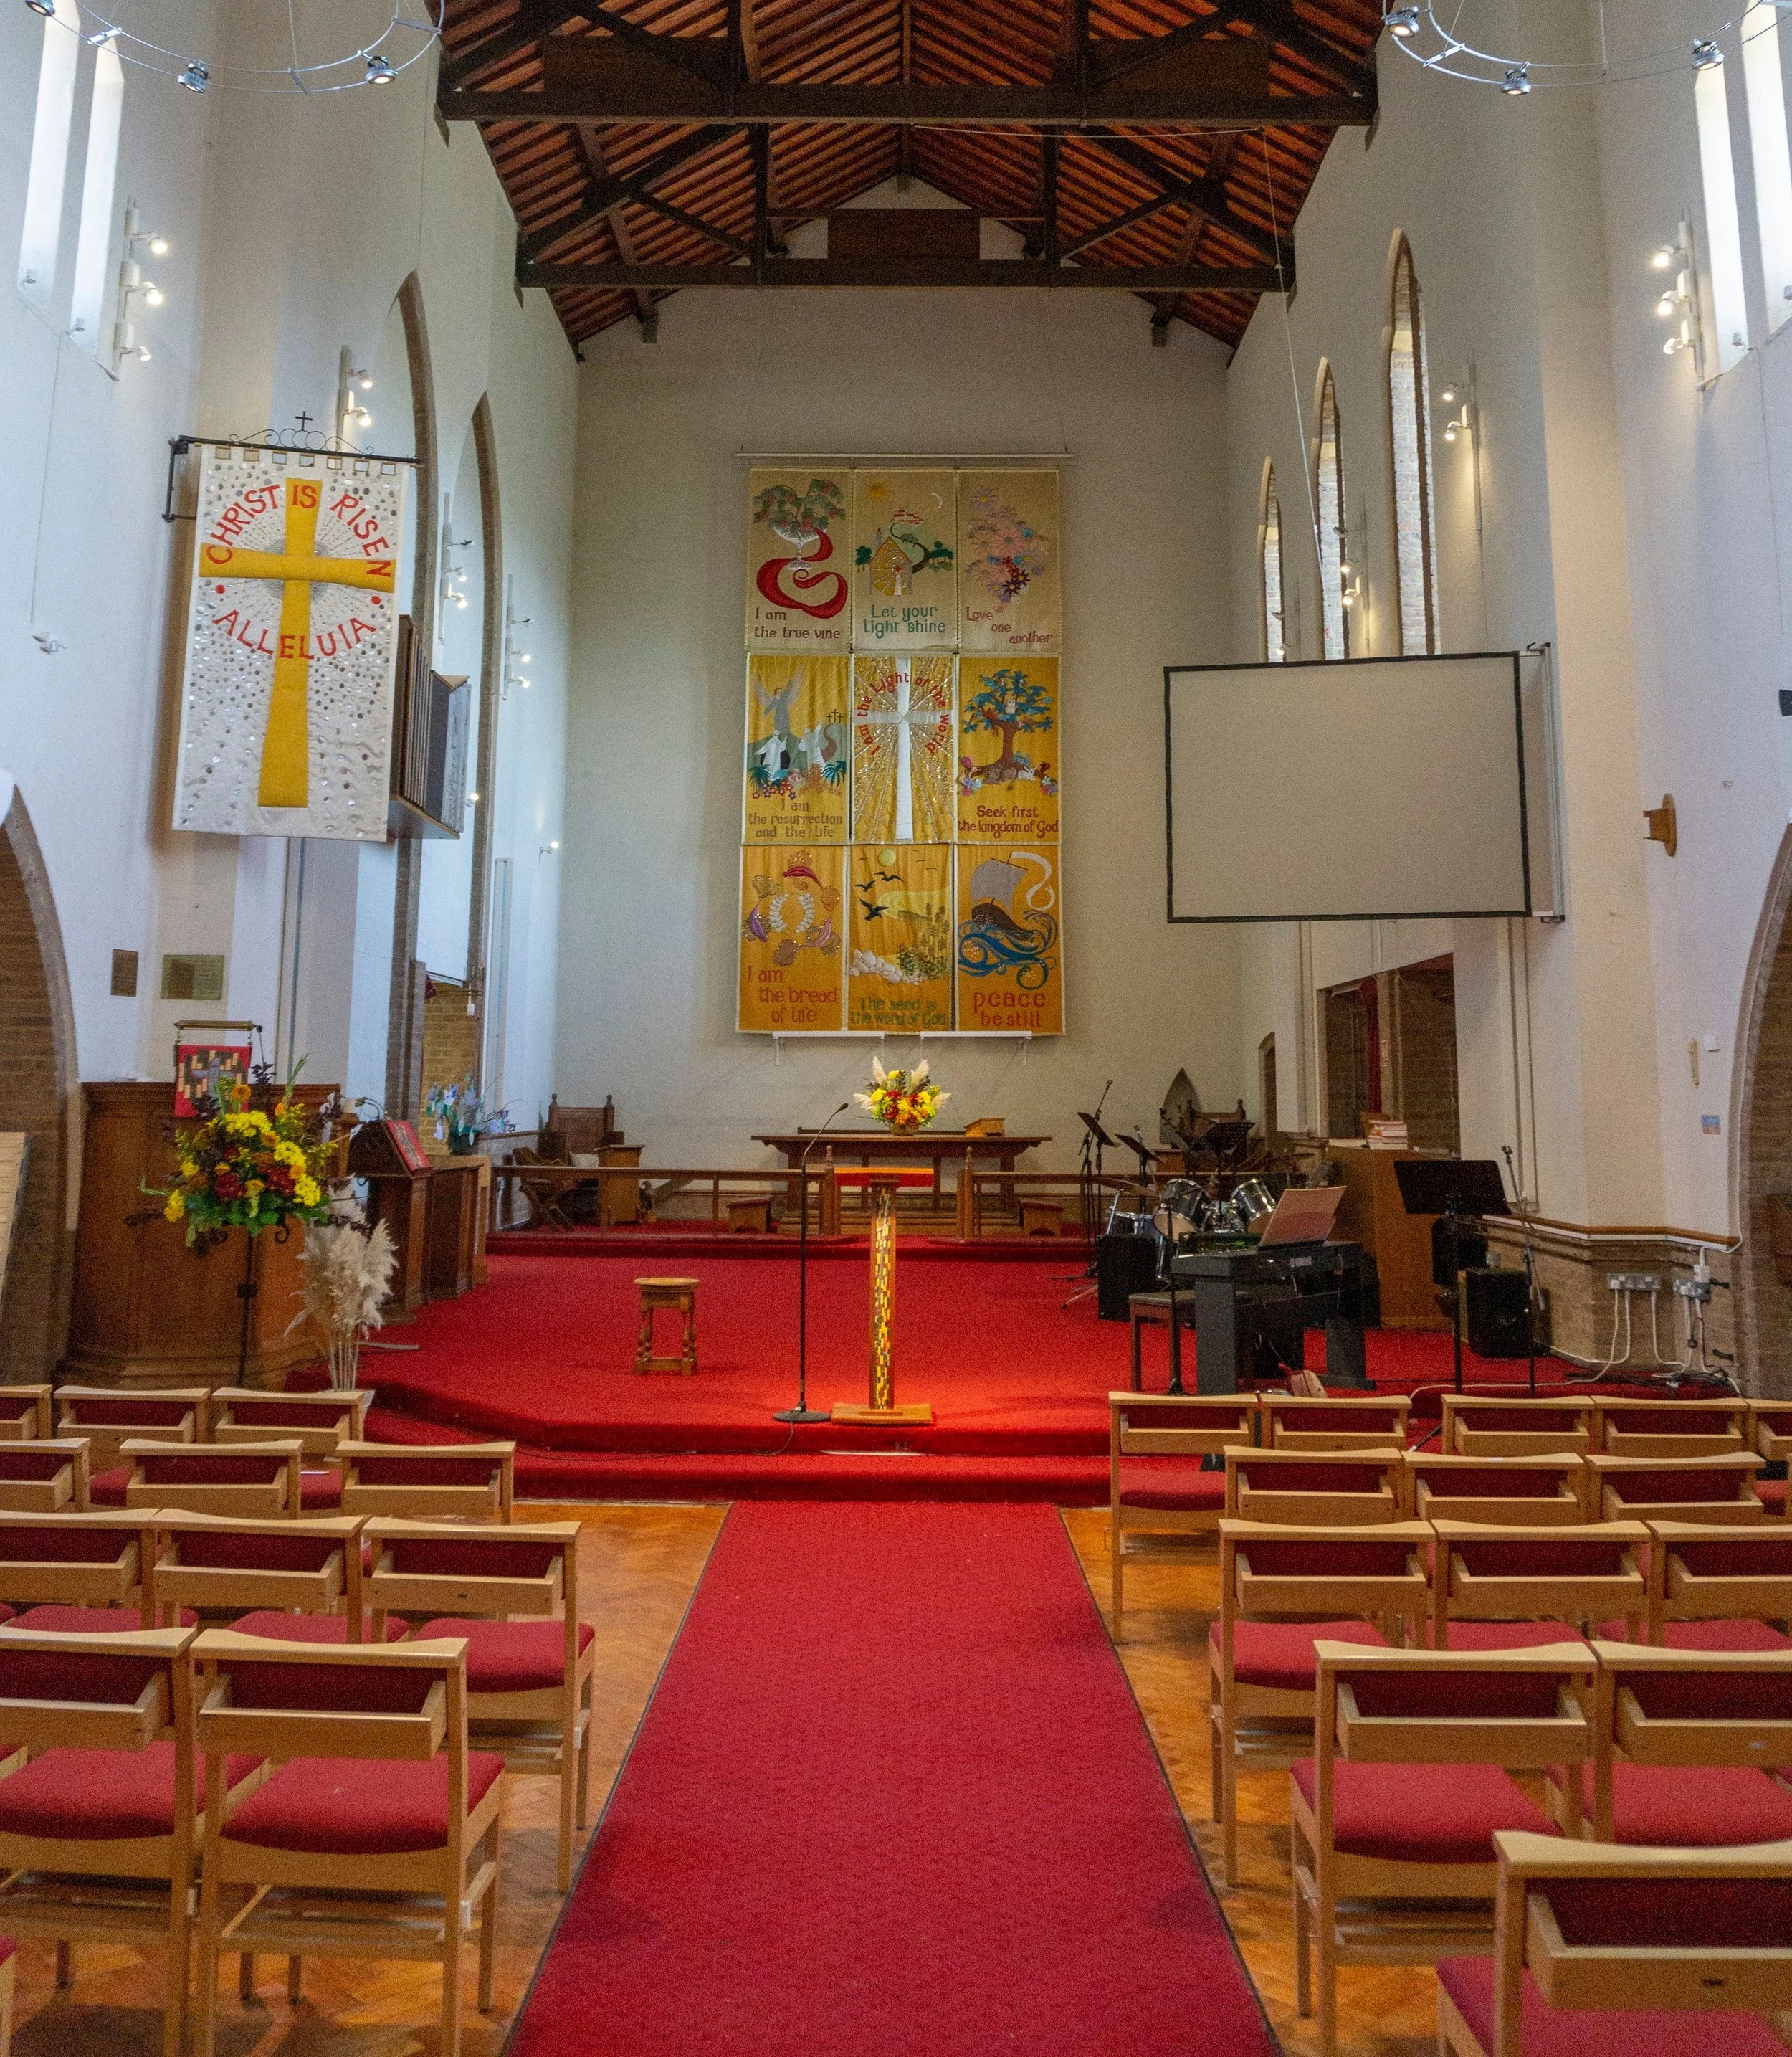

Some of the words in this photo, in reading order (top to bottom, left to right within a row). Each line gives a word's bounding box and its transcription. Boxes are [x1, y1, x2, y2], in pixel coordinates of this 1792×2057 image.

[206, 484, 280, 565] CHRIST
[291, 484, 318, 509] IS
[329, 493, 391, 578] RISEN
[755, 607, 760, 619] I
[765, 611, 786, 621] am
[871, 604, 897, 618] Let
[902, 607, 938, 622] your
[966, 607, 993, 622] Love
[754, 626, 776, 638] the
[783, 627, 809, 639] true
[814, 630, 840, 639] vine
[907, 619, 946, 633] shine
[991, 624, 1012, 632] one
[212, 609, 377, 660] ALLELUIA
[1009, 631, 1053, 644] another
[914, 676, 930, 687] of
[928, 685, 946, 708] the
[857, 695, 873, 717] the
[859, 723, 874, 745] am
[925, 713, 950, 756] world
[781, 798, 786, 811] I
[791, 802, 810, 812] am
[976, 804, 1007, 818] Seek
[1012, 805, 1039, 818] first
[748, 812, 767, 825] the
[771, 812, 843, 825] resurrection
[756, 826, 777, 838] and
[786, 826, 806, 838] the
[814, 825, 834, 838] life
[958, 820, 976, 832] the
[978, 820, 1022, 838] kingdom
[1024, 820, 1036, 832] of
[1036, 820, 1059, 839] God
[747, 964, 753, 982] I
[758, 969, 783, 983] am
[760, 987, 784, 1003] the
[788, 987, 838, 1004] bread
[973, 992, 1046, 1015] peace
[771, 1007, 786, 1022] of
[791, 1007, 816, 1023] life
[981, 1010, 1002, 1026] be
[1006, 1010, 1042, 1027] still
